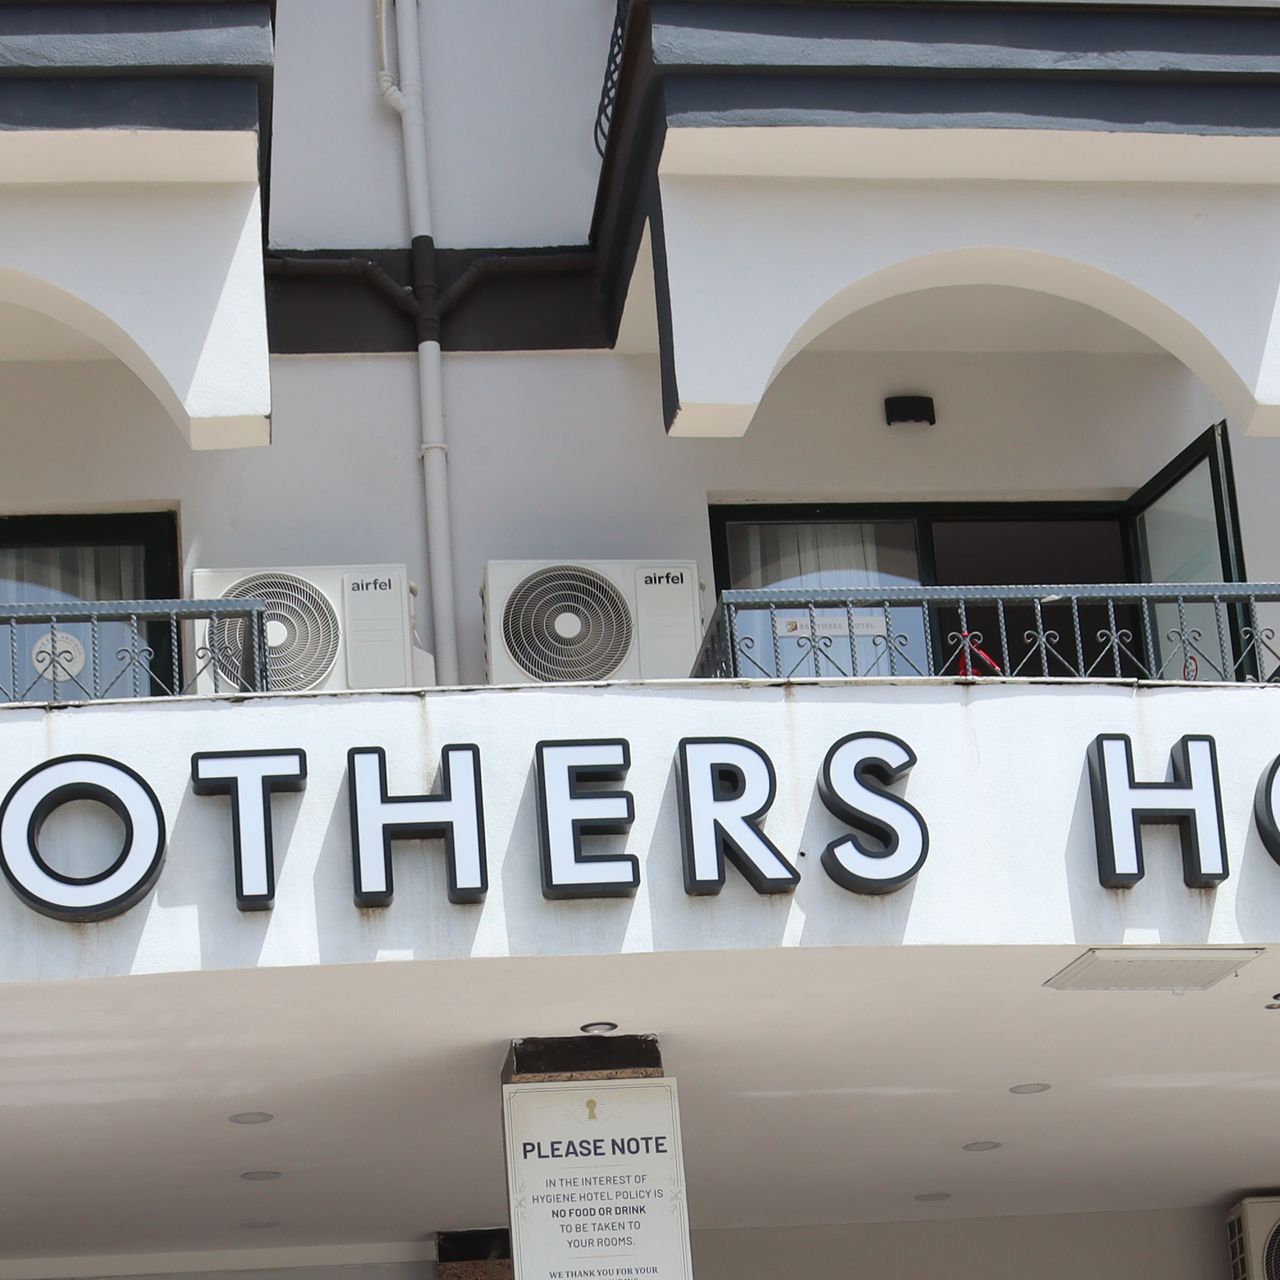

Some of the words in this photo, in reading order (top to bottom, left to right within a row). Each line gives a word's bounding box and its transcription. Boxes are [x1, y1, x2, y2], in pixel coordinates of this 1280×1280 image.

[352, 578, 392, 591] airfel
[644, 572, 684, 584] airfel
[522, 1138, 606, 1160] PLEASE
[611, 1136, 668, 1155] NOTE
[545, 1178, 556, 1188] IN
[559, 1177, 579, 1188] THE
[581, 1175, 631, 1187] INTEREST
[634, 1174, 648, 1184] OF
[531, 1193, 577, 1204] HYGIENE
[579, 1191, 613, 1202] HOTEL
[615, 1189, 651, 1200] POLICY
[654, 1188, 664, 1198] IS
[551, 1208, 566, 1218] NO
[568, 1207, 596, 1218] FOOD
[598, 1206, 613, 1216] OR
[614, 1205, 647, 1216] DRINK
[559, 1223, 573, 1233] TO
[575, 1222, 589, 1233] BE
[591, 1221, 625, 1232] TAKEN
[628, 1220, 641, 1230] TO
[566, 1238, 595, 1249] YOUR
[597, 1236, 636, 1247] ROOMS.
[549, 1271, 563, 1279] WE
[564, 1269, 595, 1279] THANK
[596, 1268, 614, 1277] YOU
[616, 1267, 633, 1276] FOR
[634, 1266, 658, 1275] YOUR
